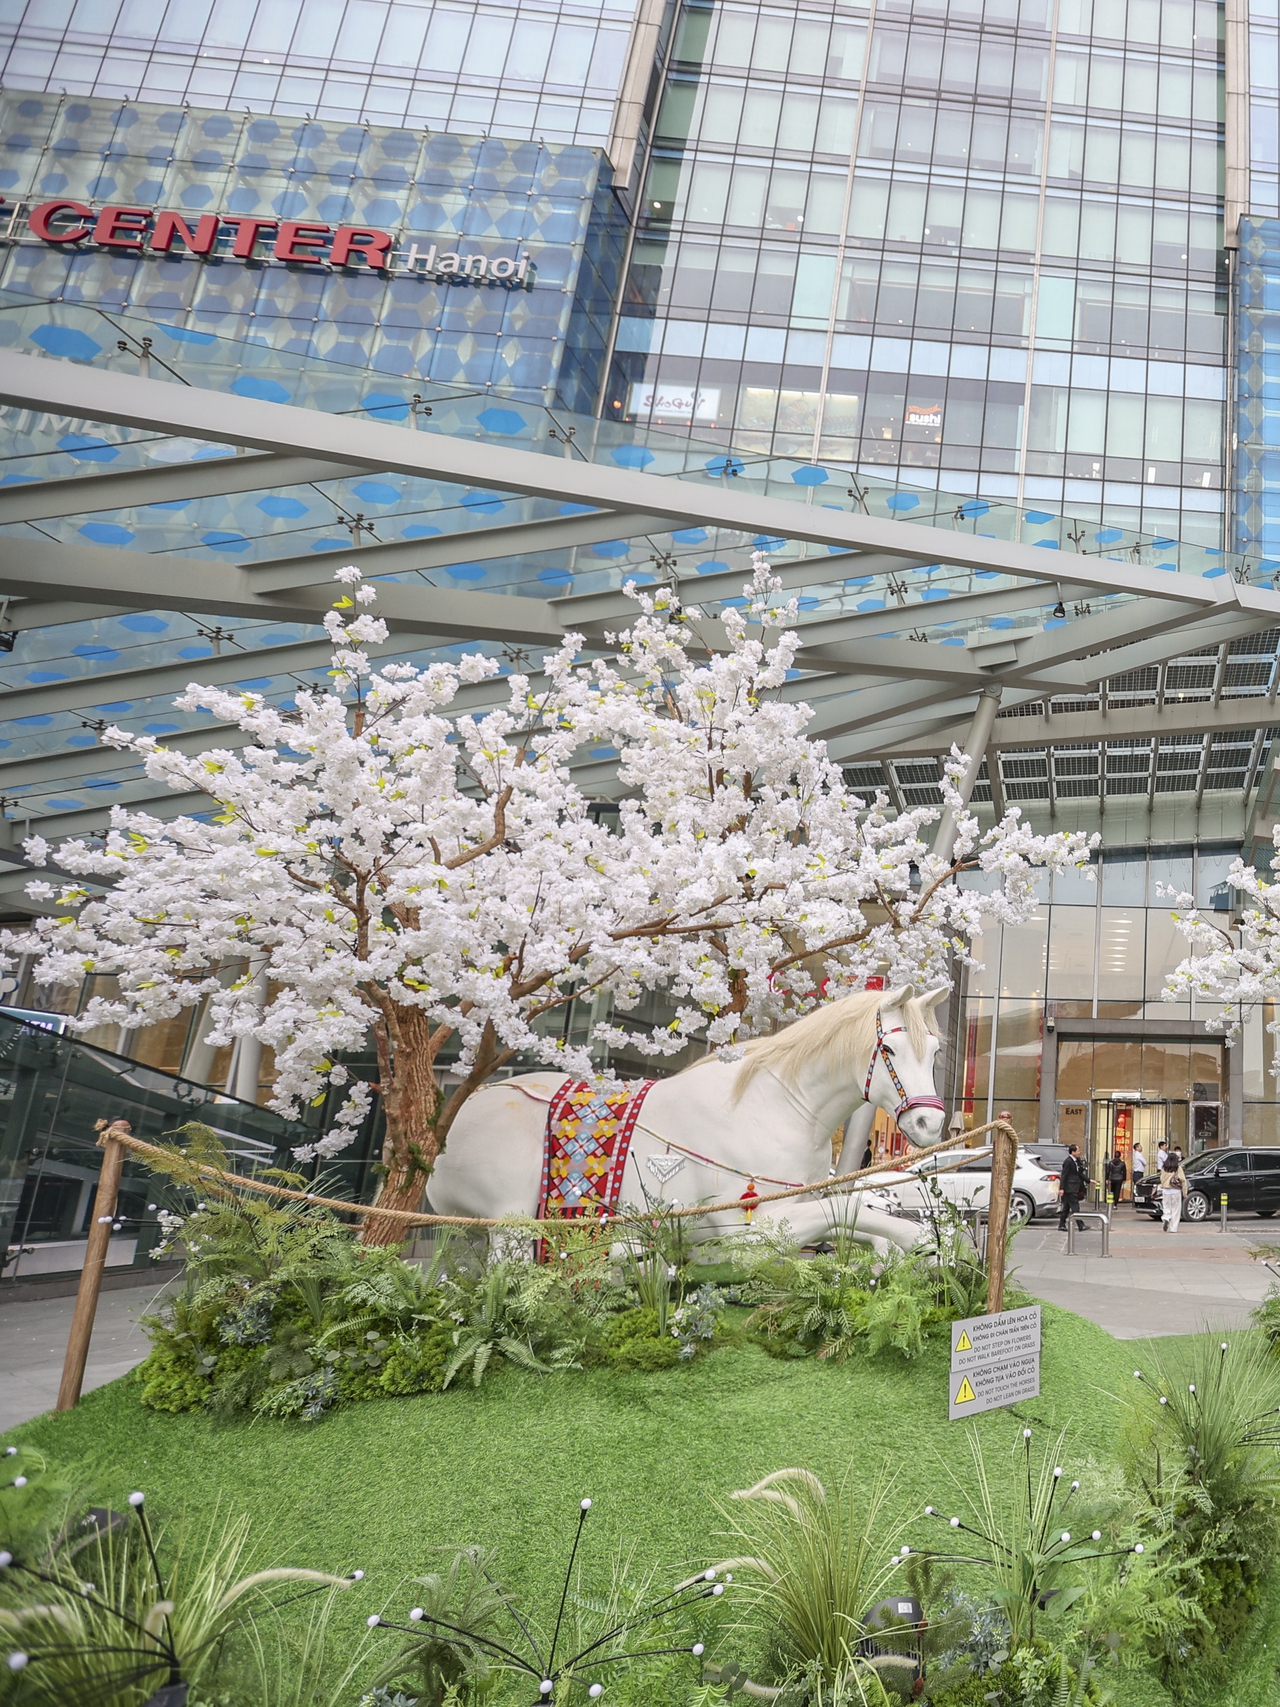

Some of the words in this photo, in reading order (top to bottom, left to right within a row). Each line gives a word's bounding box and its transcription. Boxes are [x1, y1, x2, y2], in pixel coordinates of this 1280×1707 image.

[28, 200, 394, 270] CENTER
[407, 242, 531, 281] Hanoi
[1065, 1107, 1083, 1115] EAST
[973, 1322, 992, 1332] KHÔNG
[1007, 1316, 1016, 1325] LÊN
[973, 1334, 989, 1342] KHÔNG
[992, 1341, 1003, 1349] STEP
[1012, 1334, 1032, 1344] FLOWERS
[967, 1355, 976, 1363] NOT
[977, 1352, 990, 1360] WALK
[991, 1347, 1014, 1357] BAREFOOT
[1021, 1341, 1036, 1350] GRASS
[973, 1368, 992, 1378] KHÔNG
[1009, 1360, 1020, 1368] VÀO
[975, 1378, 994, 1387] KHÔNG
[1005, 1371, 1016, 1379] VÀO
[995, 1384, 1009, 1392] TOUCH
[1019, 1377, 1035, 1386] HORSES
[1003, 1391, 1015, 1399] LEAN
[1022, 1385, 1035, 1394] GRASS
